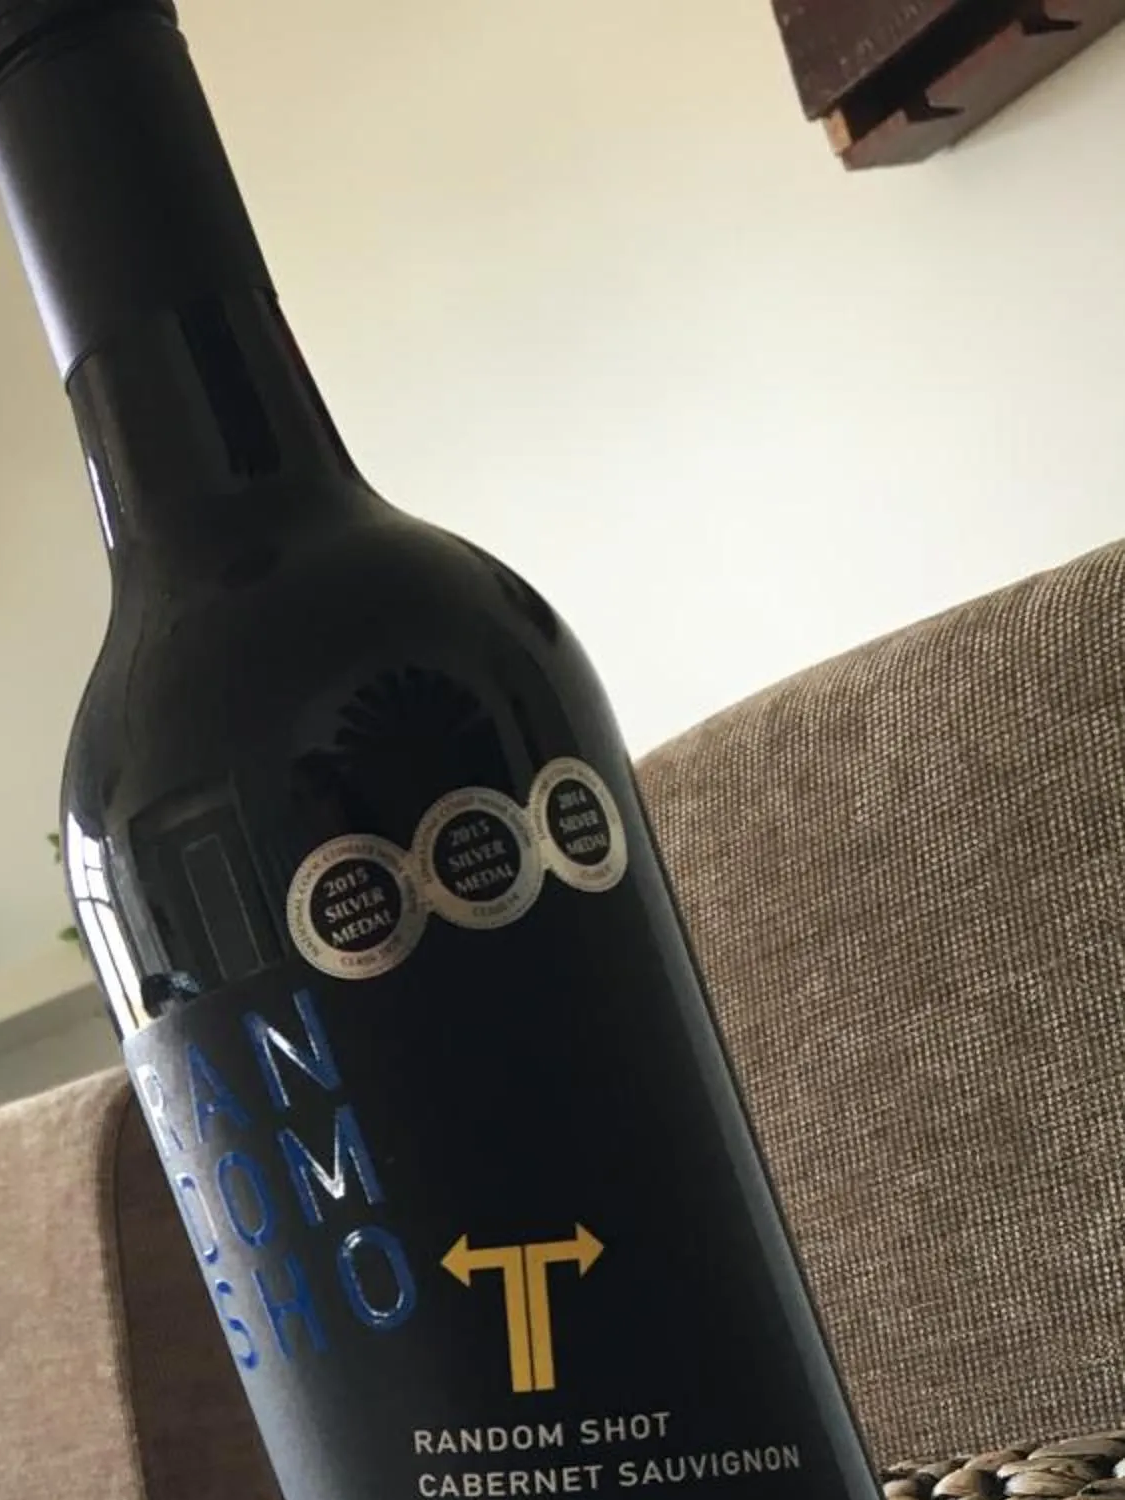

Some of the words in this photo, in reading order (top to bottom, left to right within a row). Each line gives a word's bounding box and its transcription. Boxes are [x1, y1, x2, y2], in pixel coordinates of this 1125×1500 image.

[449, 818, 491, 848] 2015
[447, 838, 508, 873] SILVER
[322, 865, 371, 899] 2015
[454, 862, 515, 896] MEDAL
[323, 885, 387, 924] SILVER
[330, 908, 395, 947] MEDAL
[413, 1423, 564, 1455] RANDOM
[580, 1411, 671, 1446] SHOT
[418, 1464, 603, 1498] CABERNET
[618, 1444, 801, 1488] SAUVIGNON
